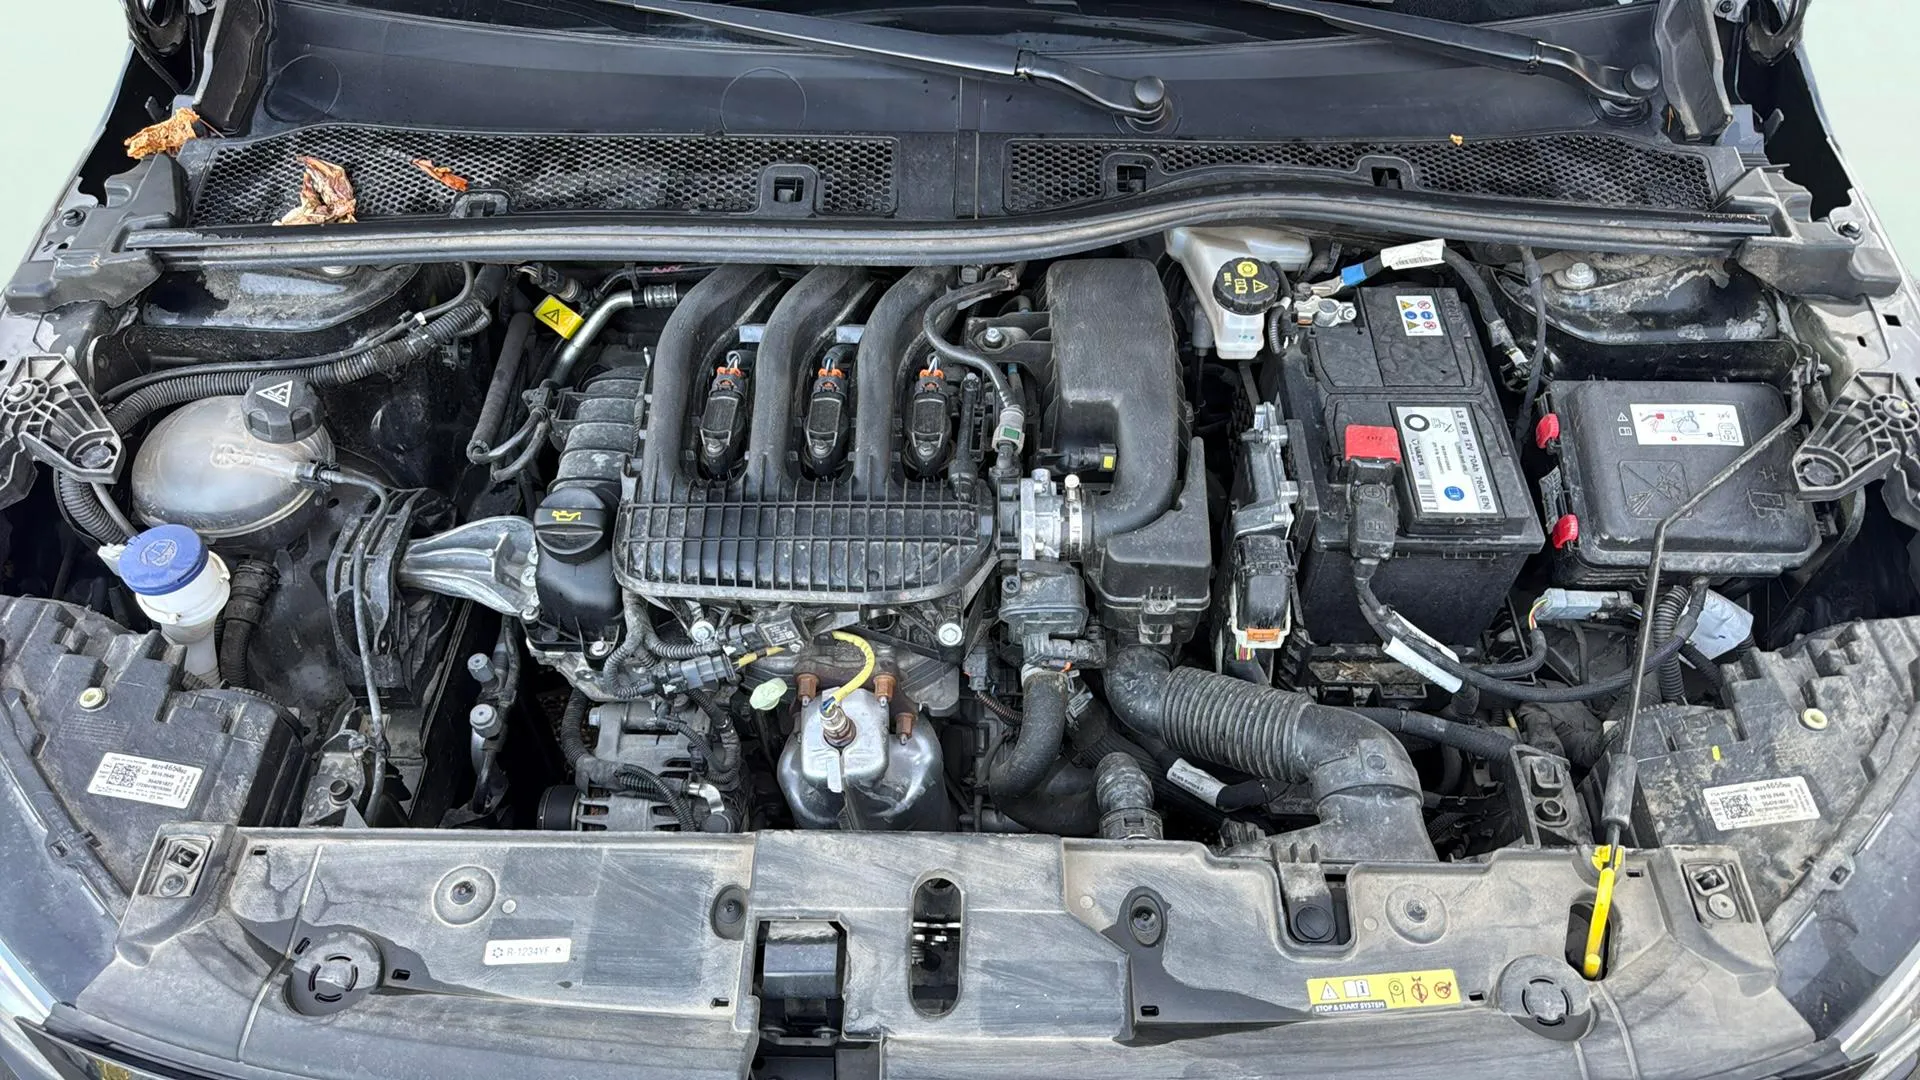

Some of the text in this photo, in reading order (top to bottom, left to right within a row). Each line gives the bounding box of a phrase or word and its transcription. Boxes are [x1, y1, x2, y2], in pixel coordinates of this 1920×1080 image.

[1414, 442, 1425, 466] VARTA
[1459, 421, 1469, 435] EFB
[1464, 439, 1474, 452] 12V
[1469, 454, 1480, 473] 70Ah
[1315, 1004, 1333, 1012] STOP
[1339, 1002, 1360, 1011] START
[1360, 1001, 1385, 1010] SYSTEM
